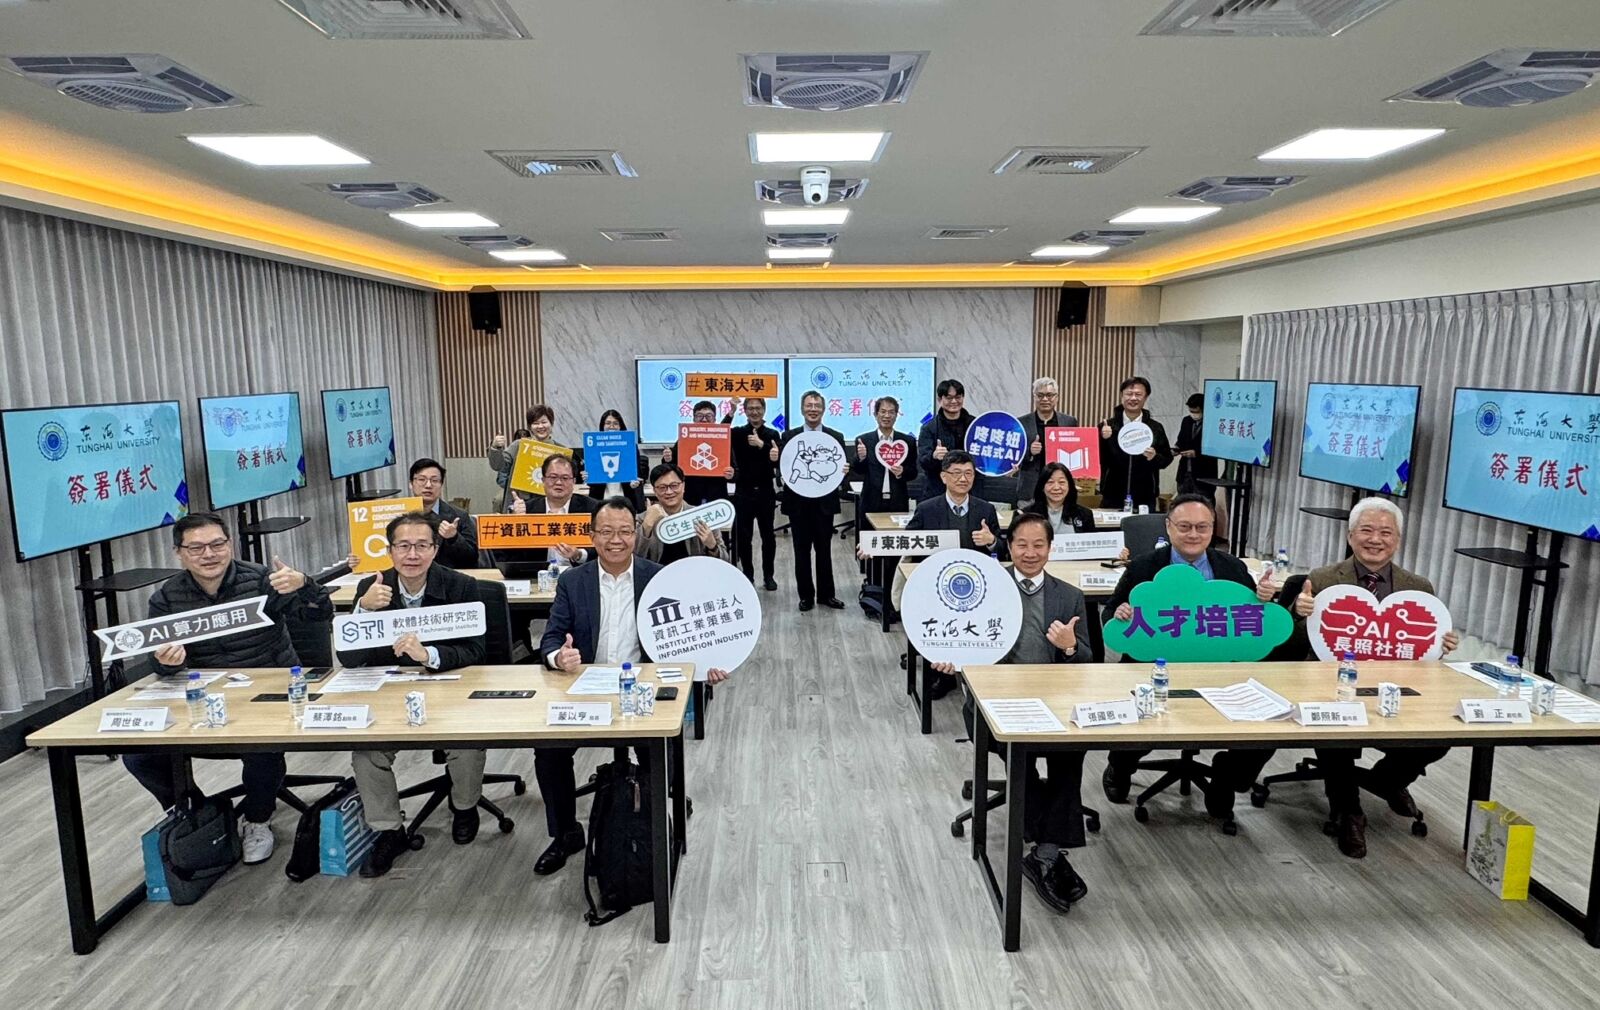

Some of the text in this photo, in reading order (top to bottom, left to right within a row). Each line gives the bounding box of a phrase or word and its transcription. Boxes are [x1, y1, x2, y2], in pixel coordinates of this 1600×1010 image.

[587, 435, 594, 447] 6
[681, 426, 688, 438] 9
[1048, 430, 1056, 442] 4
[1507, 426, 1545, 439] TUNGHAI
[76, 436, 161, 454] TUNGHAI UNIVERSITY
[523, 442, 530, 454] 7
[968, 442, 1020, 462] 生成式AI
[1490, 452, 1589, 496] 簽署儀式
[67, 464, 158, 505] 簽署儀式
[351, 506, 368, 523] 12
[689, 593, 743, 618] 財團法人
[148, 608, 248, 642] AI 算力應用
[392, 609, 479, 629] 軟體技術研究院
[652, 607, 745, 642] 資訊工業策進會
[1123, 603, 1265, 638] 人才培育
[1363, 621, 1390, 638] AI
[656, 629, 716, 651] INSTITUTE FOR
[658, 629, 754, 660] INFORMATION INDUSTRY
[1334, 636, 1416, 661] 長照社福
